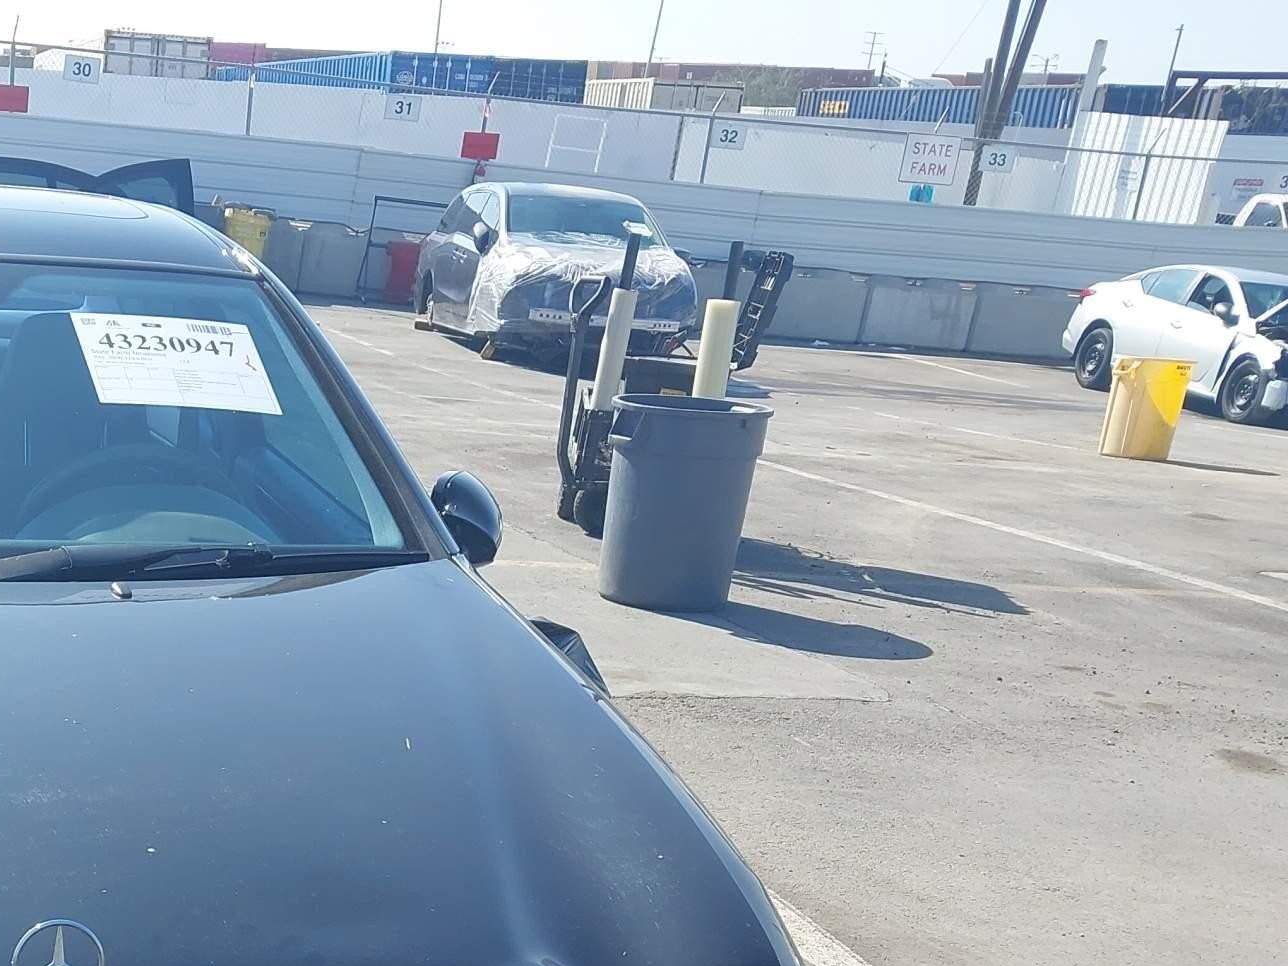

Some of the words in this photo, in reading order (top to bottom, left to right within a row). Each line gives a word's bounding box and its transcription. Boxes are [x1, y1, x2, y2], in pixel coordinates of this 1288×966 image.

[72, 62, 93, 78] 30
[394, 100, 414, 116] 31
[718, 129, 737, 144] 32
[911, 140, 953, 158] STATE
[987, 152, 1007, 167] 33
[910, 160, 948, 178] FARM
[1279, 175, 1288, 189] 3
[98, 333, 234, 357] 43230947
